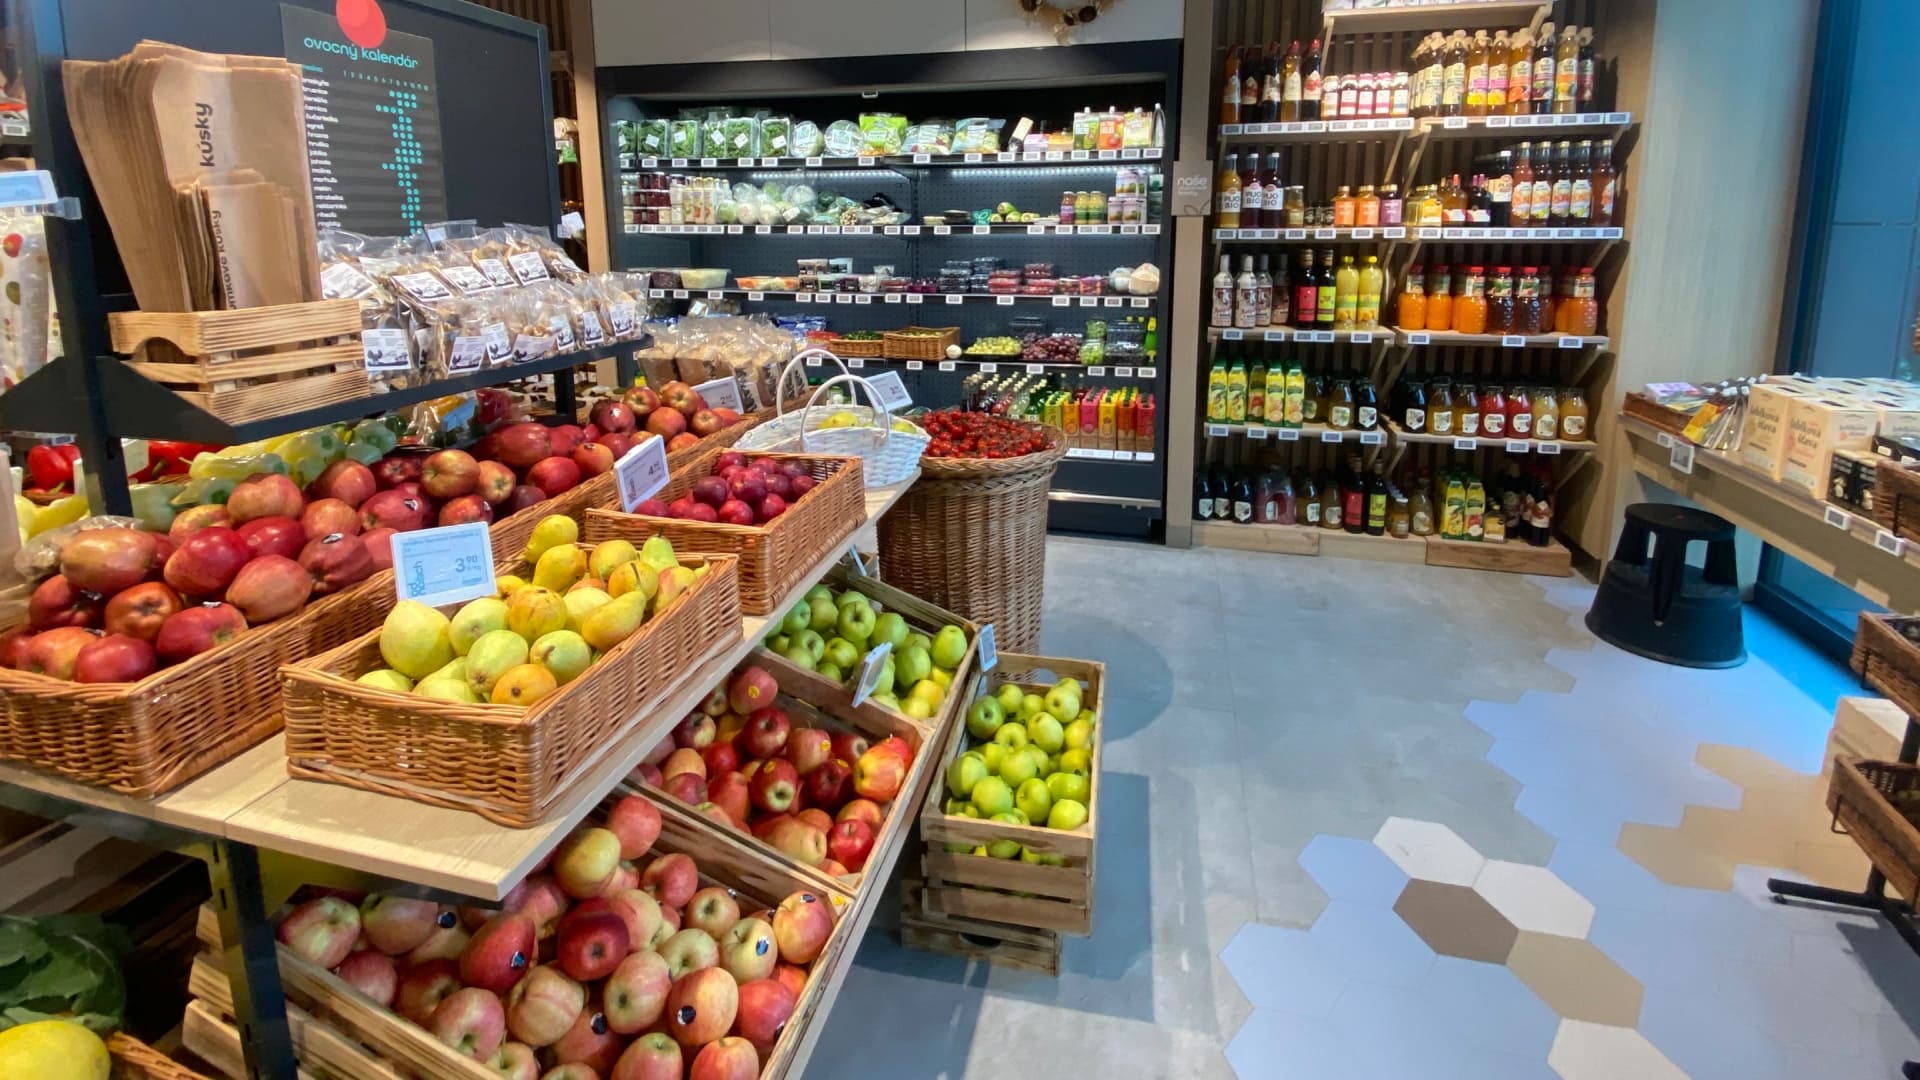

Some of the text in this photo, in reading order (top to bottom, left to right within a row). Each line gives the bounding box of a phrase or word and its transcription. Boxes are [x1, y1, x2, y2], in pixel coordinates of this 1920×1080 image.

[303, 37, 418, 68] ovocný kalendár
[195, 102, 215, 168] kúsky
[455, 555, 478, 573] 3 90
